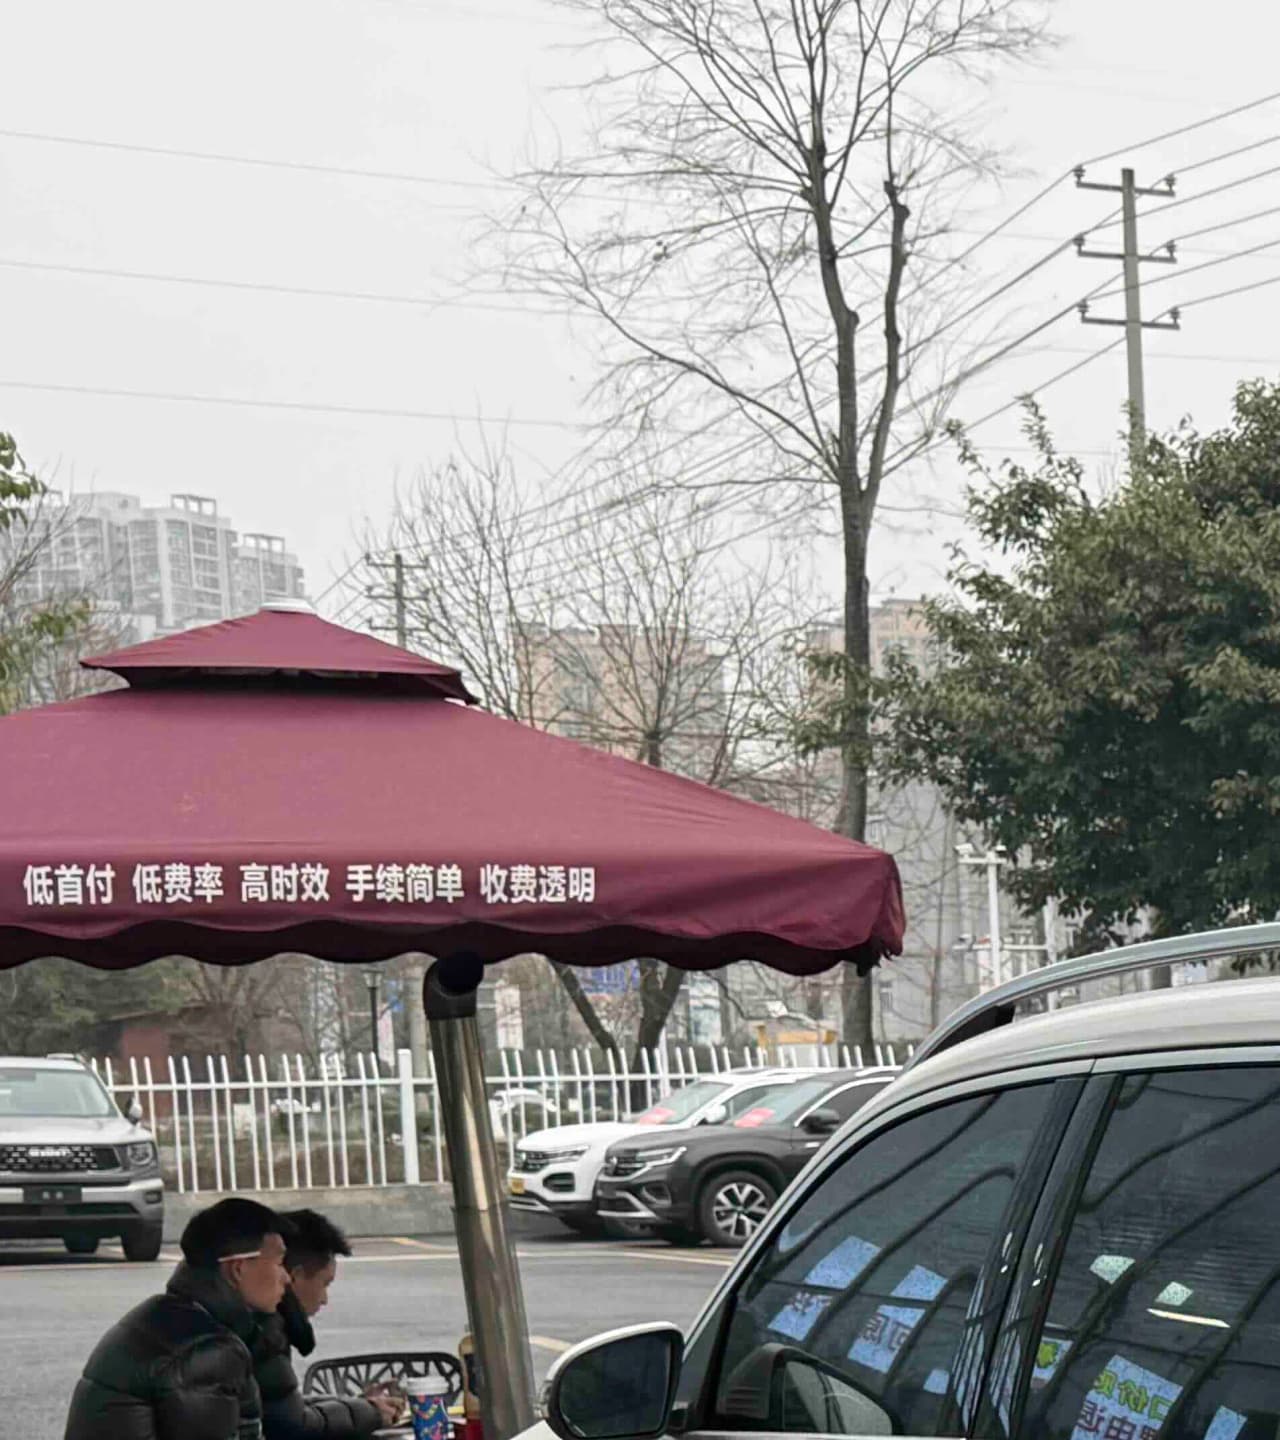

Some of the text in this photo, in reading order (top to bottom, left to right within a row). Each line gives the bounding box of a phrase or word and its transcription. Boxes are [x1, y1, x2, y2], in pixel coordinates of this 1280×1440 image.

[23, 862, 596, 905] 低首付 低费率 高时效 手续简单 收费透明
